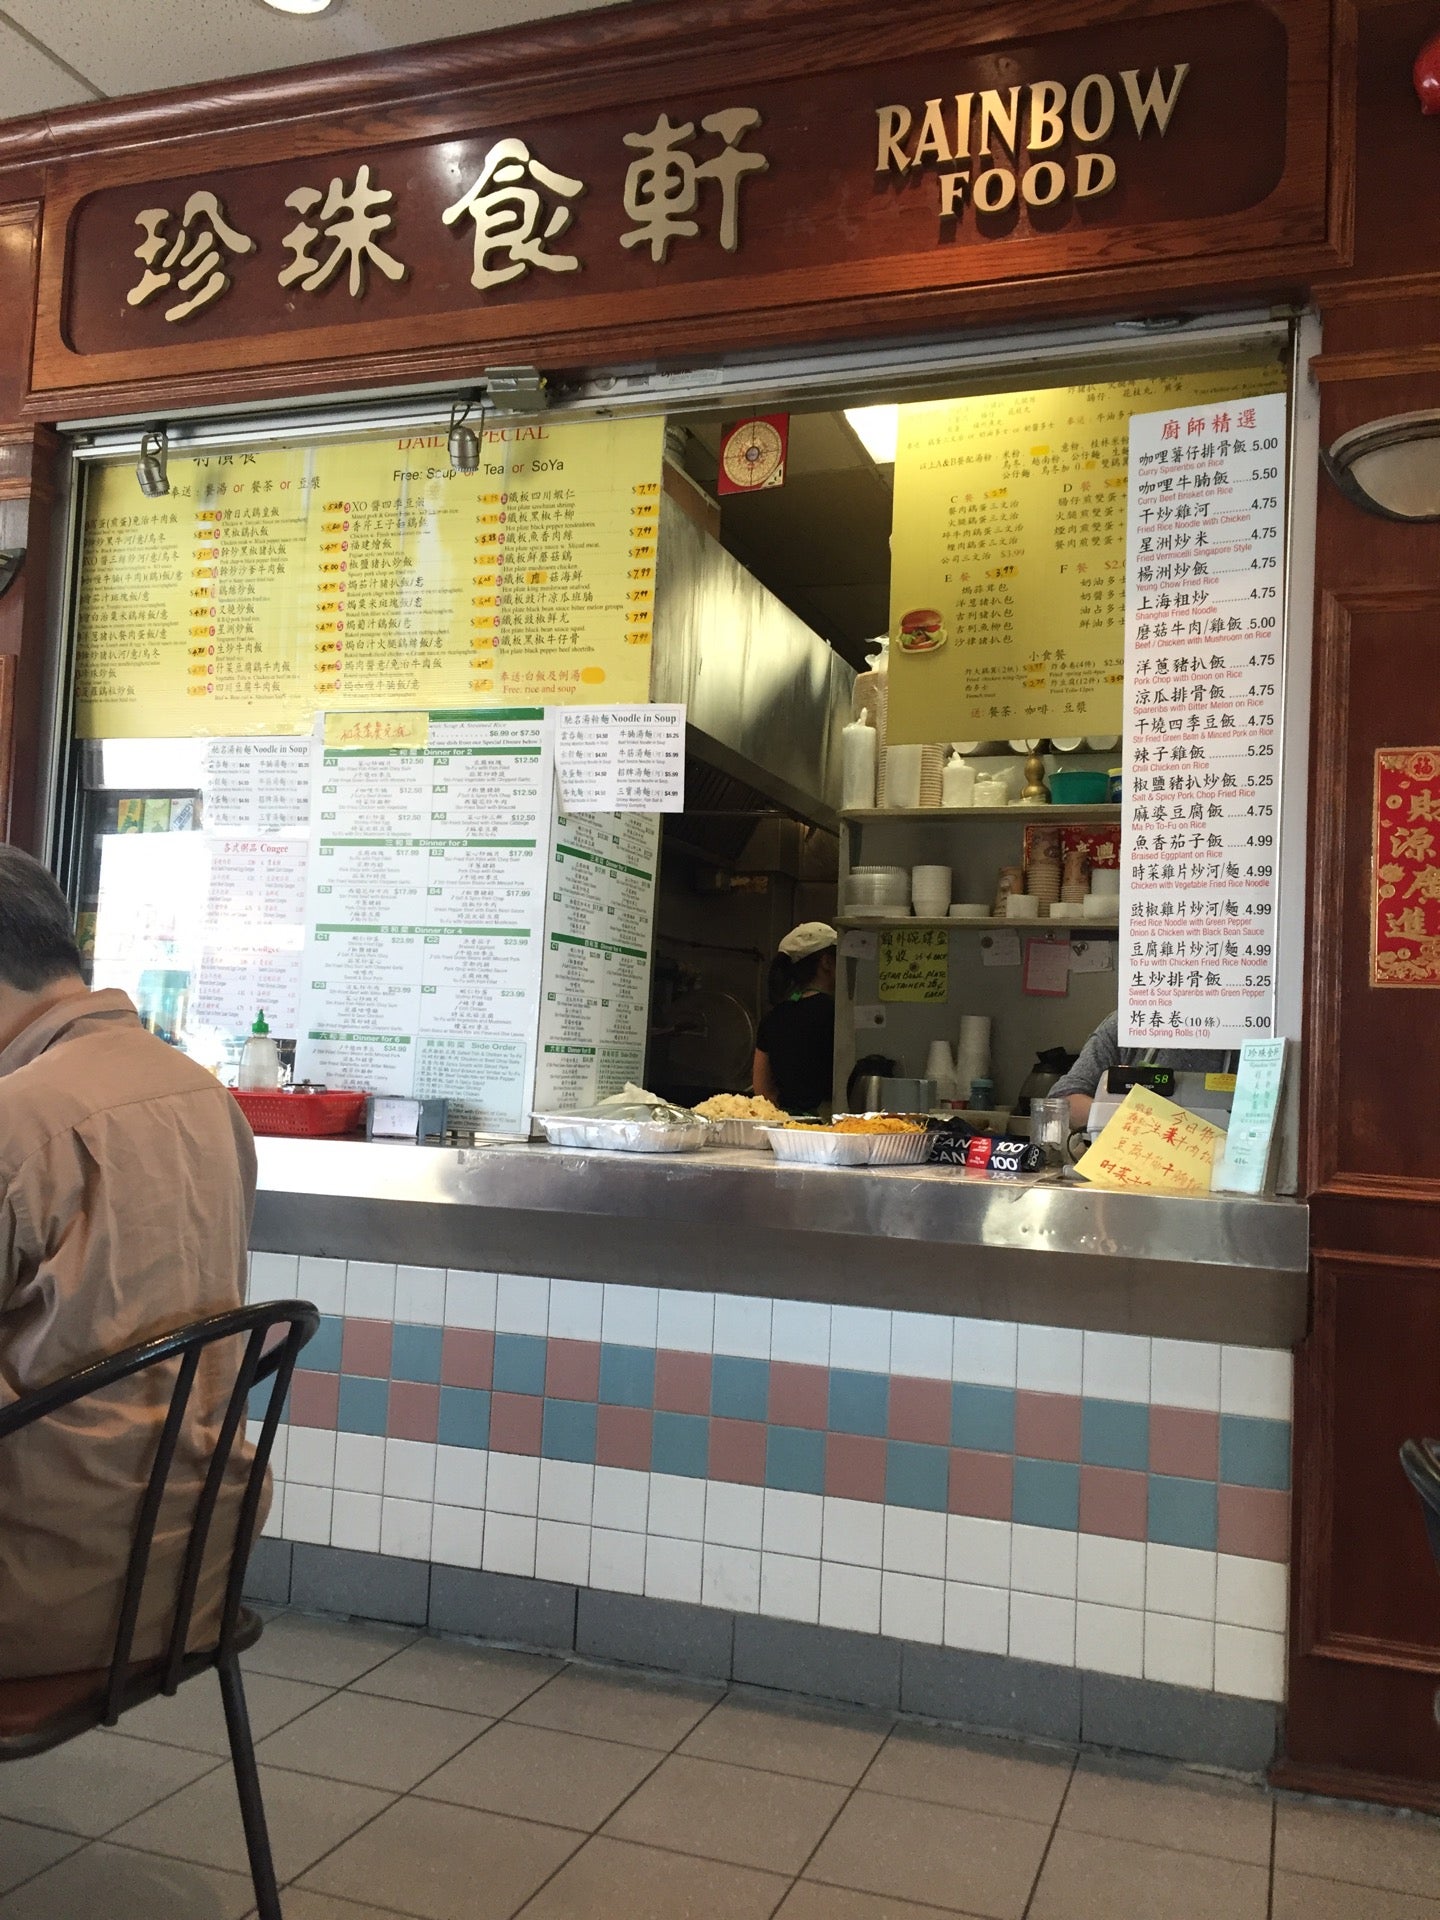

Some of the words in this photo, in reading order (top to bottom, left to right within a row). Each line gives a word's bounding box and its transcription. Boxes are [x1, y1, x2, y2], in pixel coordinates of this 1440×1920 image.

[875, 63, 1190, 172] RAINBOW
[938, 150, 1117, 219] FOOD
[127, 107, 769, 324] 珍珠食軒
[1161, 408, 1257, 441] 廚師精選
[1252, 437, 1278, 452] 5.00
[393, 469, 423, 481] Free:
[484, 463, 505, 475] Tea
[512, 464, 525, 473] or
[531, 459, 565, 472] SoYa
[233, 484, 245, 493] or
[280, 481, 292, 489] or
[1063, 483, 1073, 493] D
[1138, 470, 1230, 495] 咖哩牛腩飯
[1252, 467, 1278, 481] 5.50
[1139, 502, 1211, 525] 干炒雞河
[1251, 496, 1278, 510] 4.75
[1136, 524, 1155, 534] Fried
[1156, 523, 1174, 532] Rice
[1174, 519, 1201, 529] Noodle
[1201, 517, 1219, 526] with
[1220, 514, 1251, 524] Chicken
[1139, 530, 1210, 554] 星洲炒米
[1251, 526, 1277, 540] 4.75
[1136, 553, 1155, 563] Fried
[1156, 549, 1192, 561] Vermicelli
[1193, 546, 1232, 557] Singapore
[1233, 543, 1253, 553] Style
[1060, 565, 1068, 574] F
[1250, 556, 1277, 570] 4.75
[944, 574, 952, 583] E
[1136, 583, 1158, 592] Yeung
[1159, 580, 1181, 589] Chow
[1182, 577, 1202, 587] Fried
[1202, 576, 1219, 585] Rice
[1137, 589, 1210, 611] 上海粗炒
[1250, 586, 1276, 600] 4.75
[1135, 610, 1170, 621] Shanghai
[1171, 608, 1191, 617] Fried
[1191, 606, 1218, 615] Noodle
[1250, 616, 1276, 630] 5.00
[1028, 649, 1067, 662] 小食餐
[1248, 653, 1275, 667] 4.75
[1133, 676, 1150, 685] Pork
[1152, 675, 1172, 685] Chop
[1173, 674, 1189, 682] with
[1190, 672, 1213, 680] Onion
[1226, 670, 1243, 678] Rice
[503, 685, 522, 695] Free:
[524, 684, 540, 694] rice
[542, 683, 556, 693] and
[557, 685, 577, 696] soup
[1248, 683, 1275, 697] 4.75
[612, 713, 641, 724] Noodle
[643, 714, 652, 723] in
[654, 713, 677, 724] Soup
[1135, 713, 1235, 735] 干燒四季豆飯
[1247, 714, 1275, 727] 4.75
[520, 729, 541, 737] $7.50
[253, 745, 278, 754] Noodle
[279, 745, 287, 753] in
[289, 745, 308, 755] Soup
[1134, 744, 1206, 764] 辣子雞飯
[1247, 744, 1274, 757] 5.25
[1132, 764, 1149, 773] Chili
[1150, 763, 1180, 772] Chicken
[1193, 761, 1210, 769] Rice
[1133, 772, 1238, 794] 椒鹽豬扒炒飯
[1247, 774, 1274, 787] 5.25
[1132, 802, 1224, 823] 麻婆豆腐飯
[1246, 804, 1273, 817] 4.75
[1133, 832, 1225, 852] 魚香茄子飯
[1246, 834, 1273, 847] 4.99
[1246, 865, 1273, 877] 4.99
[1245, 903, 1272, 916] 4.99
[1245, 944, 1272, 957] 4.99
[1129, 958, 1139, 966] To
[1139, 958, 1150, 966] Fu
[1150, 958, 1167, 966] with
[1168, 958, 1200, 966] Chicken
[1200, 958, 1220, 966] Fried
[1221, 957, 1239, 966] Rice
[1240, 958, 1268, 966] Noodle
[1130, 970, 1223, 988] 生炒排骨飯
[1245, 975, 1272, 987] 5.25
[1245, 1016, 1272, 1028] 5.00
[1128, 1028, 1147, 1036] Fried
[1148, 1028, 1174, 1039] Spring
[1175, 1028, 1193, 1037] Rolls
[1195, 1029, 1211, 1037] (10)
[491, 1042, 517, 1051] Order
